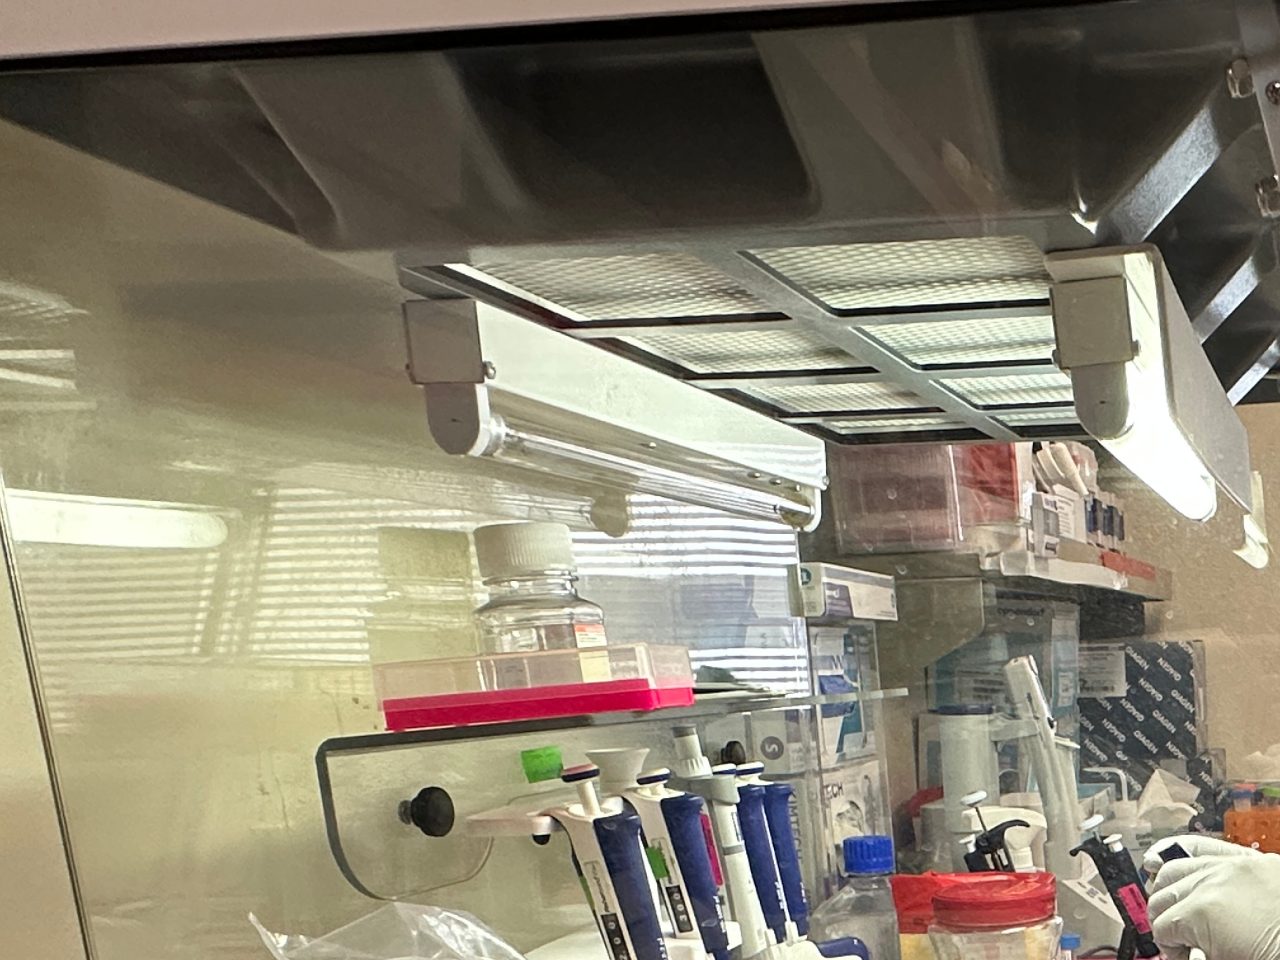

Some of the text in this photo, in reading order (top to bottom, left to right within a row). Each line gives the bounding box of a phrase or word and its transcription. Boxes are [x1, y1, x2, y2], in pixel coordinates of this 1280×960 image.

[1125, 646, 1149, 670] QIAGEN
[1157, 657, 1181, 681] QIAGEN
[1138, 678, 1163, 701] QIAGEN
[1171, 689, 1195, 713] QIAGEN
[1120, 698, 1144, 721] QIAGEN
[1152, 709, 1176, 733] QIAGEN
[1102, 718, 1126, 742] QIAGEN
[1133, 730, 1158, 754] QIAGEN
